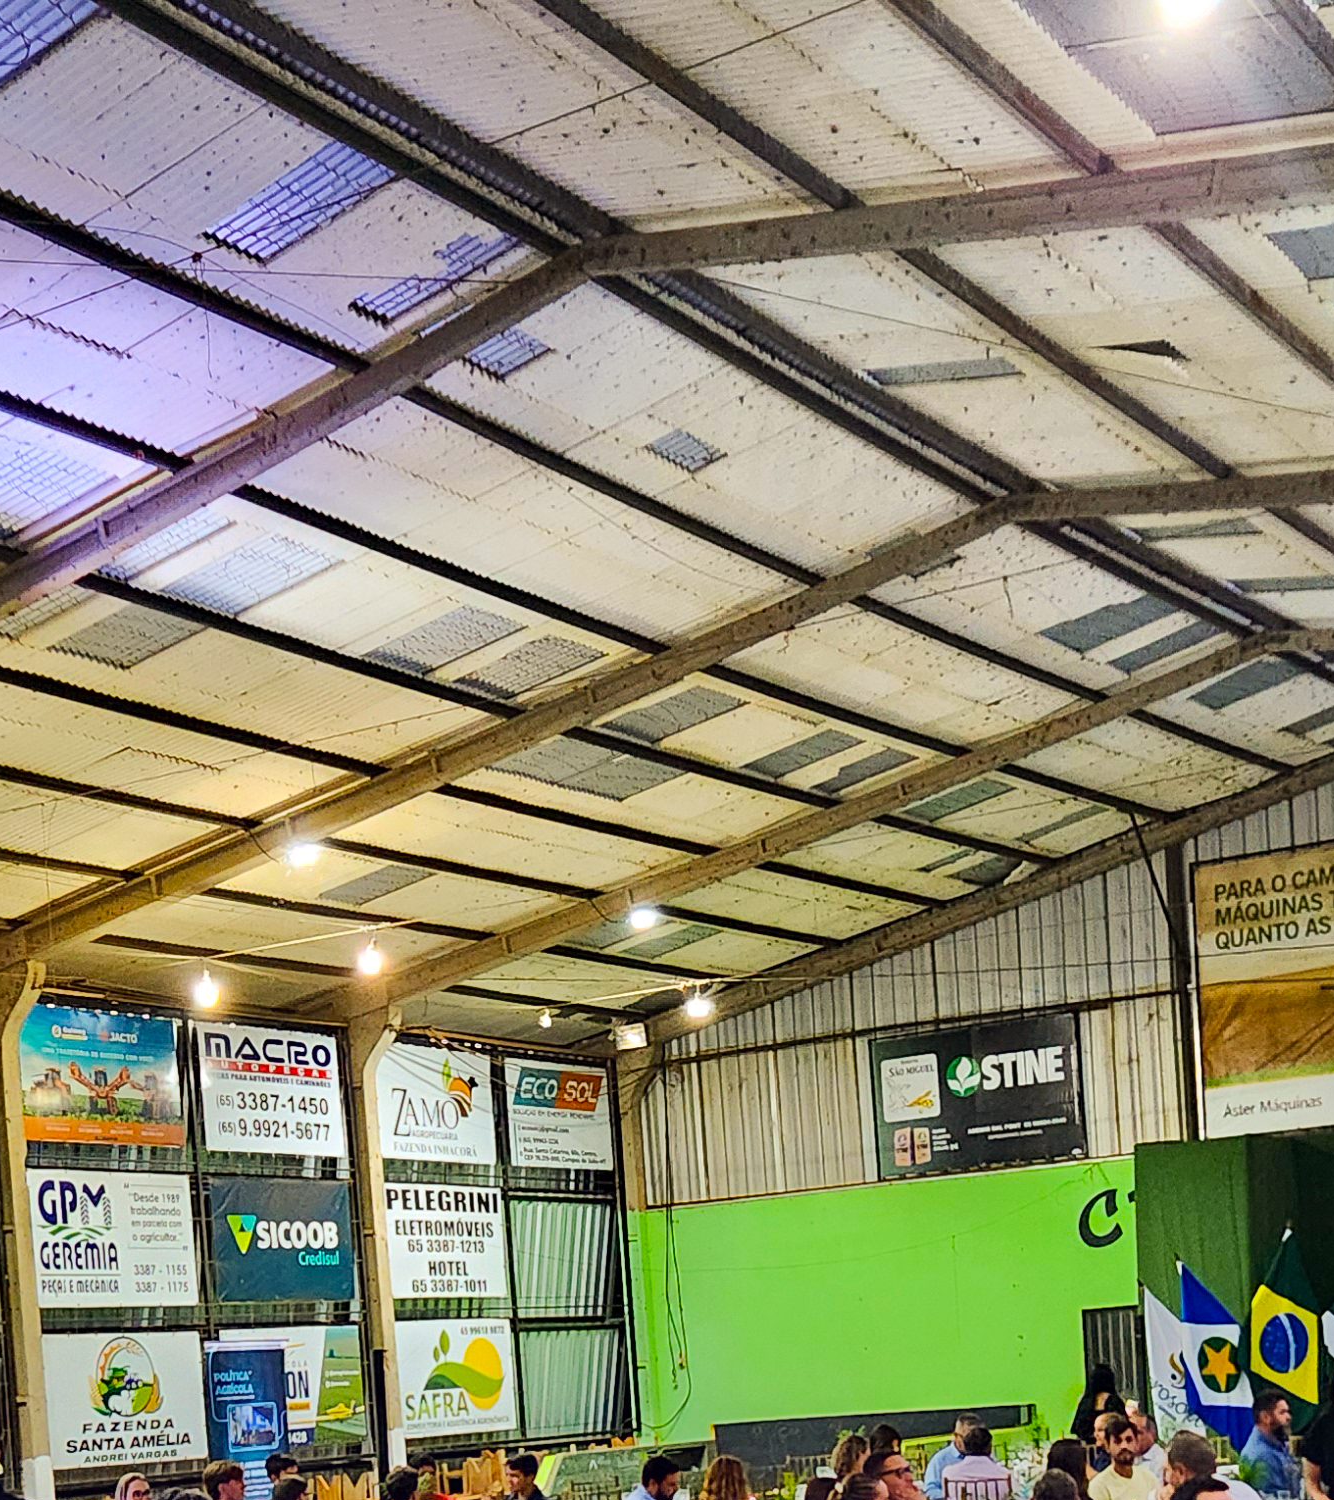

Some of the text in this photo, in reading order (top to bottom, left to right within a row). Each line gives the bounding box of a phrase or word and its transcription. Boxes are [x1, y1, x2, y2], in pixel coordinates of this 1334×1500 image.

[1215, 879, 1266, 902] PARA
[1272, 875, 1285, 892] O
[1215, 893, 1323, 926] MÁQUINAS
[1216, 921, 1298, 950] QUANTO
[1305, 917, 1331, 937] AS
[109, 1032, 138, 1043] JACTO
[204, 1032, 331, 1067] MACRO
[889, 1067, 904, 1078] SÃO
[981, 1046, 1065, 1091] STINE
[520, 1077, 598, 1103] ECO SOL
[216, 1091, 328, 1115] (65) 3387-1450
[392, 1088, 459, 1136] ZAMO
[218, 1118, 330, 1141] (65) 9.9921-5677
[394, 1141, 433, 1154] FAZENDA
[38, 1179, 112, 1225] GPM
[131, 1206, 181, 1216] trabalhando
[386, 1188, 498, 1214] PELEGRINI
[256, 1221, 339, 1249] SICOOB
[395, 1218, 494, 1238] ELETROMÓVEIS
[40, 1241, 119, 1271] GEREMIA
[408, 1239, 485, 1253] 65 3387-1213
[298, 1251, 339, 1266] Credisul
[428, 1261, 469, 1276] HOTEL
[134, 1264, 188, 1275] 3387 1155
[42, 1279, 67, 1297] PEÇAS
[70, 1280, 74, 1292] E
[135, 1282, 189, 1292] 3387 1175
[412, 1279, 487, 1293] 65 3387-1011
[213, 1369, 250, 1382] POLÍTICA
[215, 1383, 254, 1395] AGRÍCOLA
[405, 1391, 469, 1420] SAFRA
[83, 1418, 174, 1434] FAZENDA
[66, 1430, 191, 1453] SANTA AMÉLIA
[84, 1449, 177, 1463] ANDREI VARGAS
